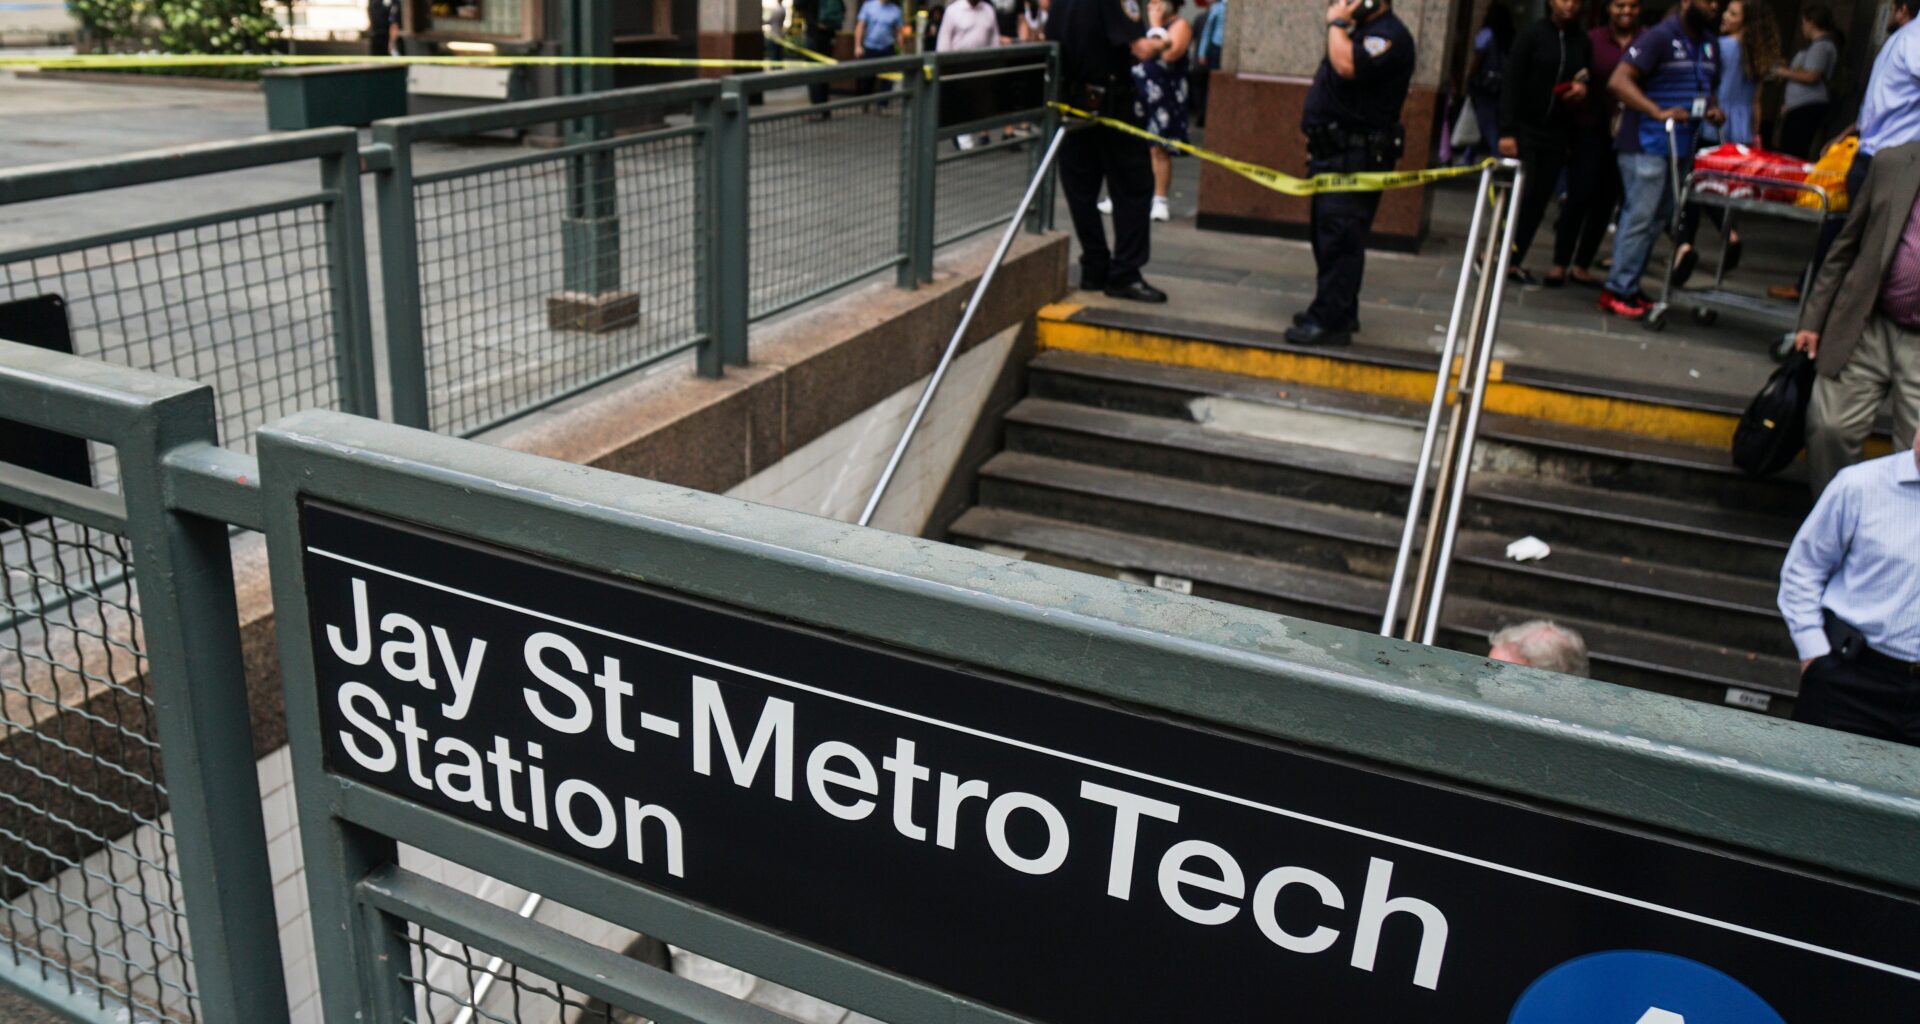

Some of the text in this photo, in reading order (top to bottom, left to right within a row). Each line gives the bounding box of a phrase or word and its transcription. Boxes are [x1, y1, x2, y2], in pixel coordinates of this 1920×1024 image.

[326, 577, 1449, 991] Jay St-MetroTech
[337, 681, 684, 878] Station
